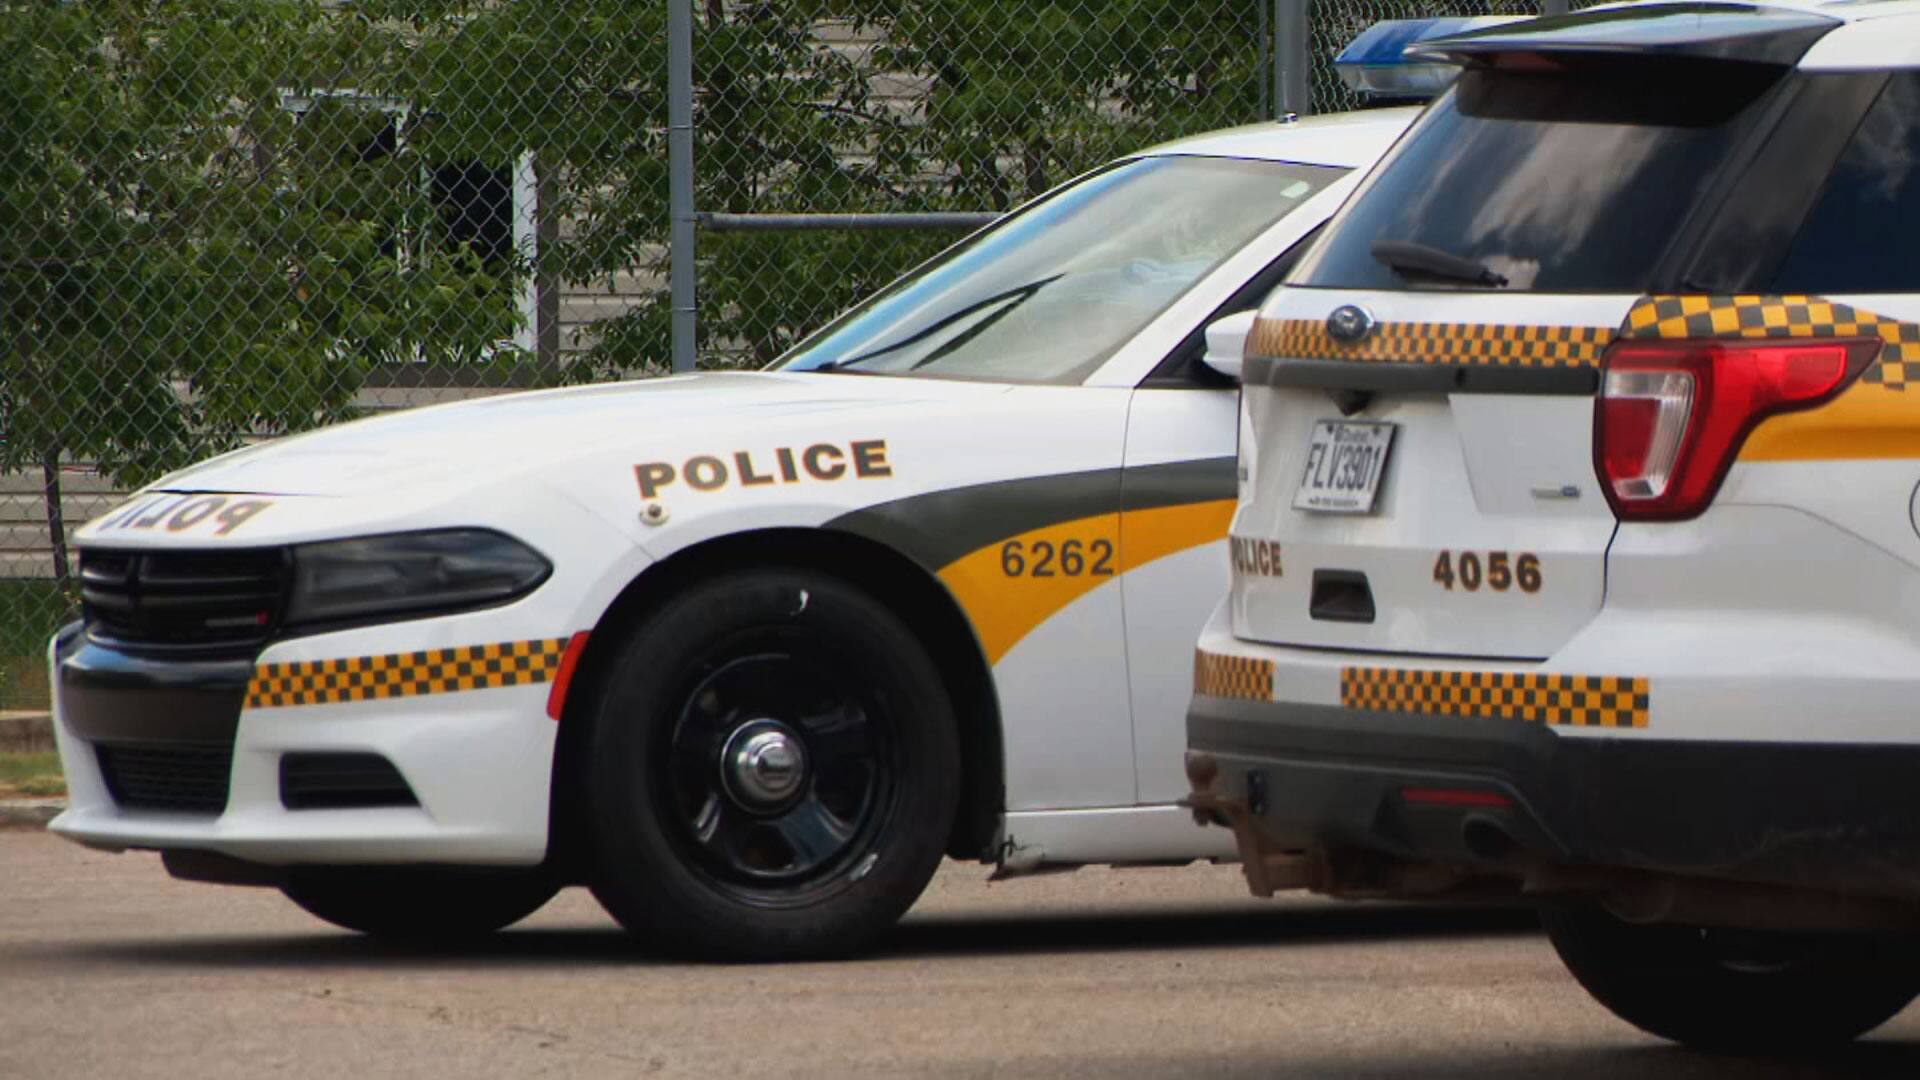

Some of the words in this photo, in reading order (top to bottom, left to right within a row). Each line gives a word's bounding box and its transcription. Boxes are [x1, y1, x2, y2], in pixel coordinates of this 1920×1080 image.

[633, 438, 893, 500] POLICE
[1000, 538, 1116, 578] 6262
[1432, 549, 1543, 594] 4056
